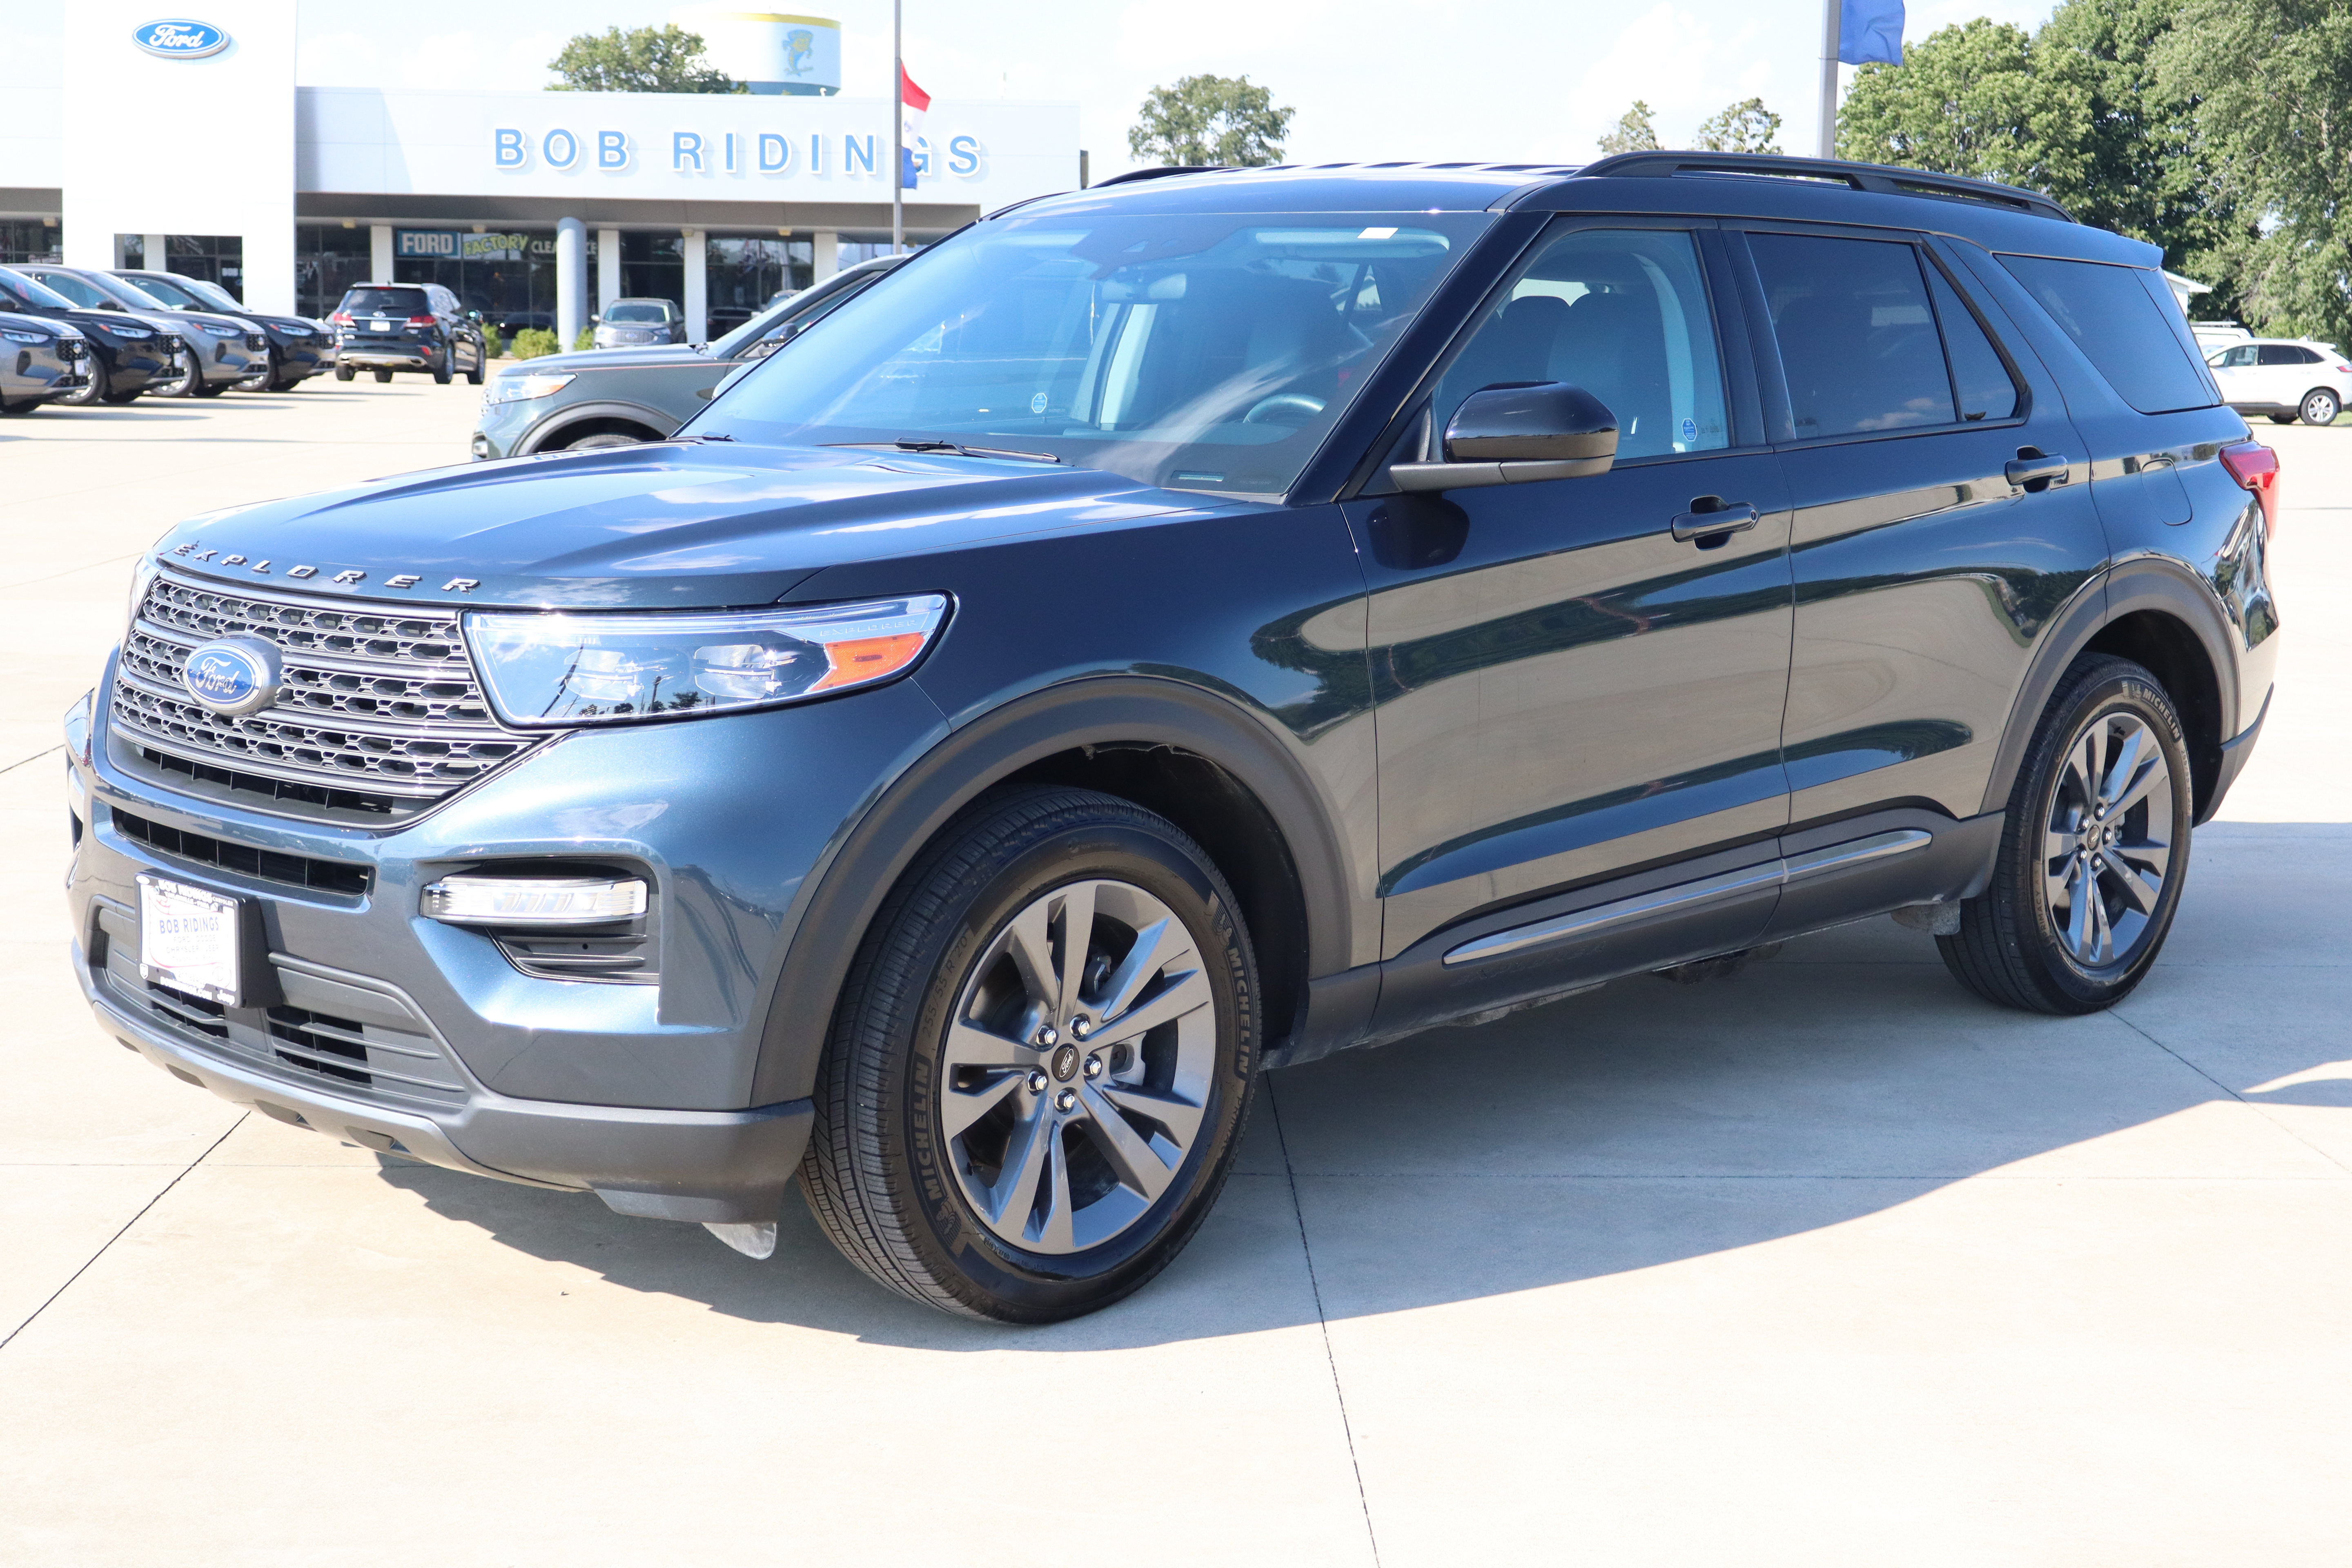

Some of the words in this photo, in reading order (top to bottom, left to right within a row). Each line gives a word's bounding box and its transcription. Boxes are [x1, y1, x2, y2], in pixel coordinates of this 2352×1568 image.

[149, 24, 205, 48] Ford
[494, 128, 630, 171] BOB
[672, 131, 982, 178] RIDINGS
[401, 233, 454, 254] FORD
[463, 234, 529, 256] FACTORY
[172, 542, 481, 593] EXPLORER
[819, 620, 918, 637] EXPLORER
[196, 657, 238, 694] Ford
[2143, 688, 2181, 740] MICHELIN
[159, 919, 179, 934] BOB
[184, 916, 219, 933] RIDINGS
[922, 975, 948, 1038] 255/55
[947, 961, 955, 975] R
[955, 935, 968, 959] 20
[1227, 946, 1250, 1075] MICHELIN
[1062, 1053, 1072, 1073] Ford
[913, 1064, 942, 1201] MICHELIN
